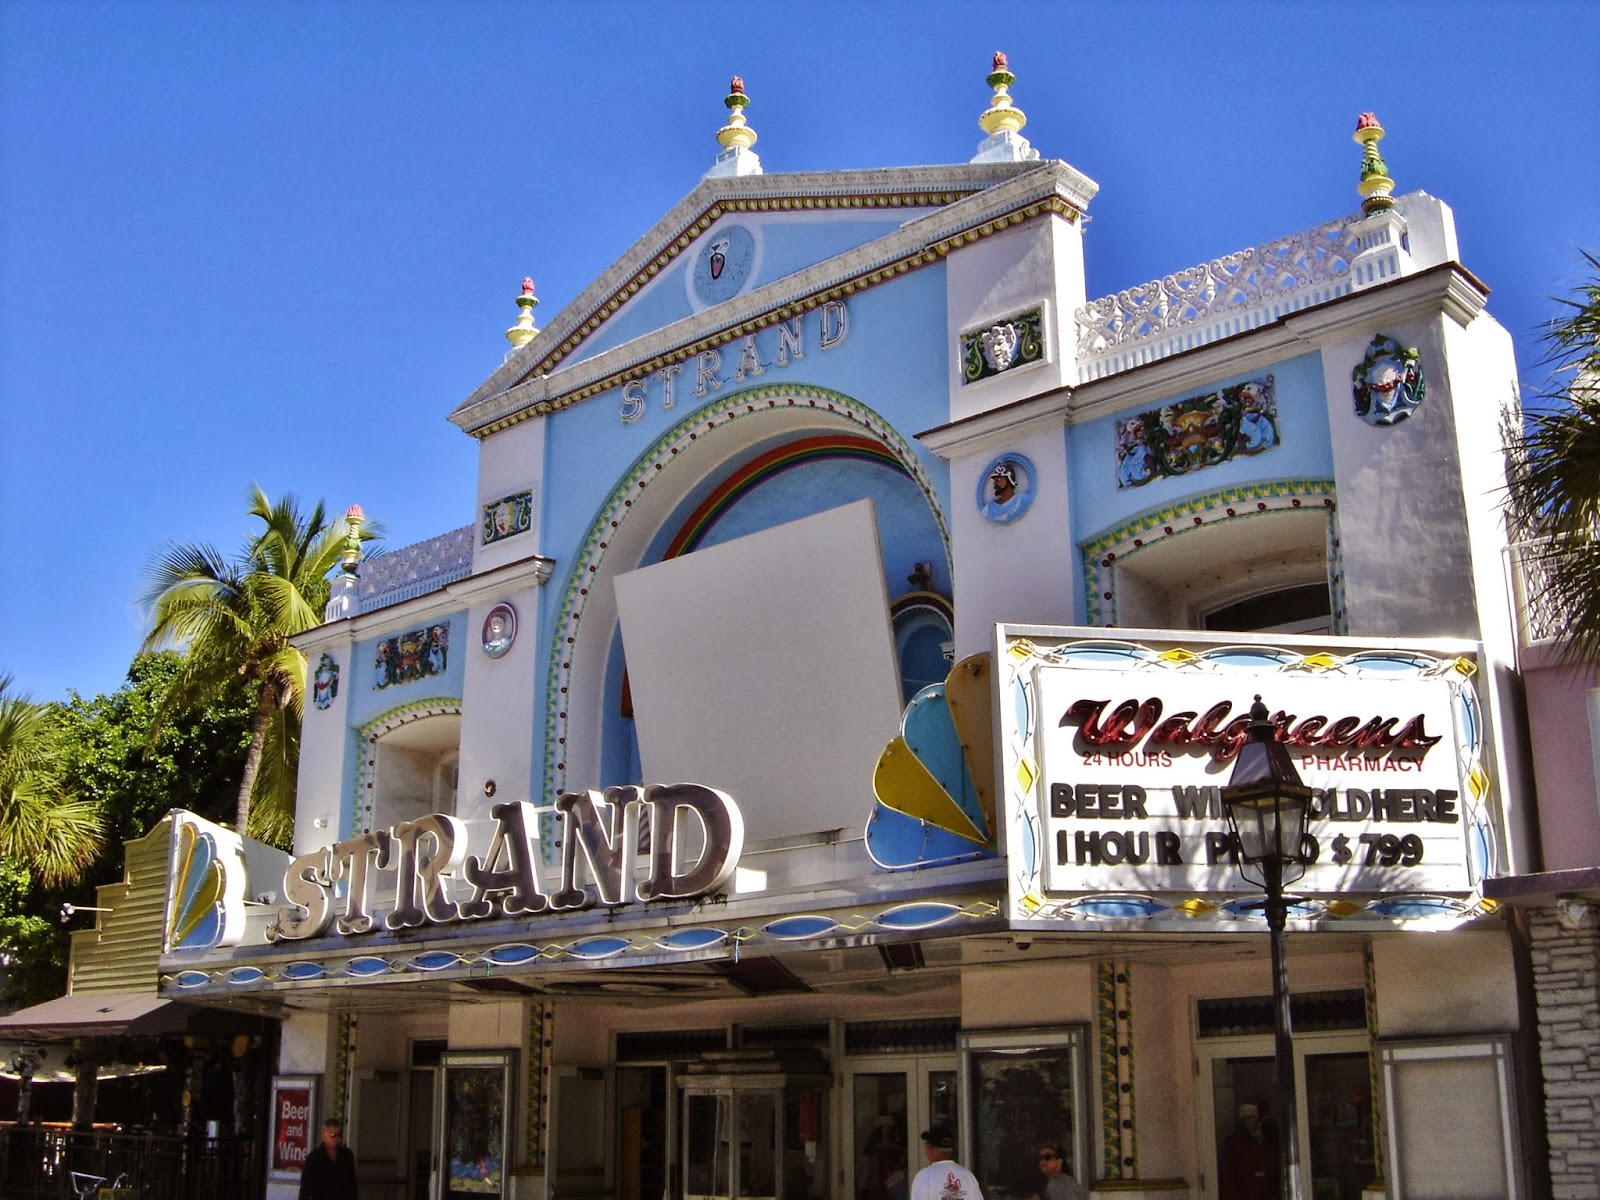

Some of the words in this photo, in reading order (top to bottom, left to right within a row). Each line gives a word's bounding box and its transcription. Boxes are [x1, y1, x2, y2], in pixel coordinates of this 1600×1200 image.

[621, 301, 848, 424] STRAND
[1064, 697, 1442, 762] Walgreens
[1083, 752, 1101, 766] 24
[1109, 752, 1172, 767] HOURS
[1302, 755, 1424, 772] PHARMACY
[1051, 783, 1149, 819] BEER
[264, 783, 745, 942] STRAND
[282, 1101, 308, 1119] Beer
[286, 1123, 303, 1136] and
[280, 1141, 308, 1161] Wine
